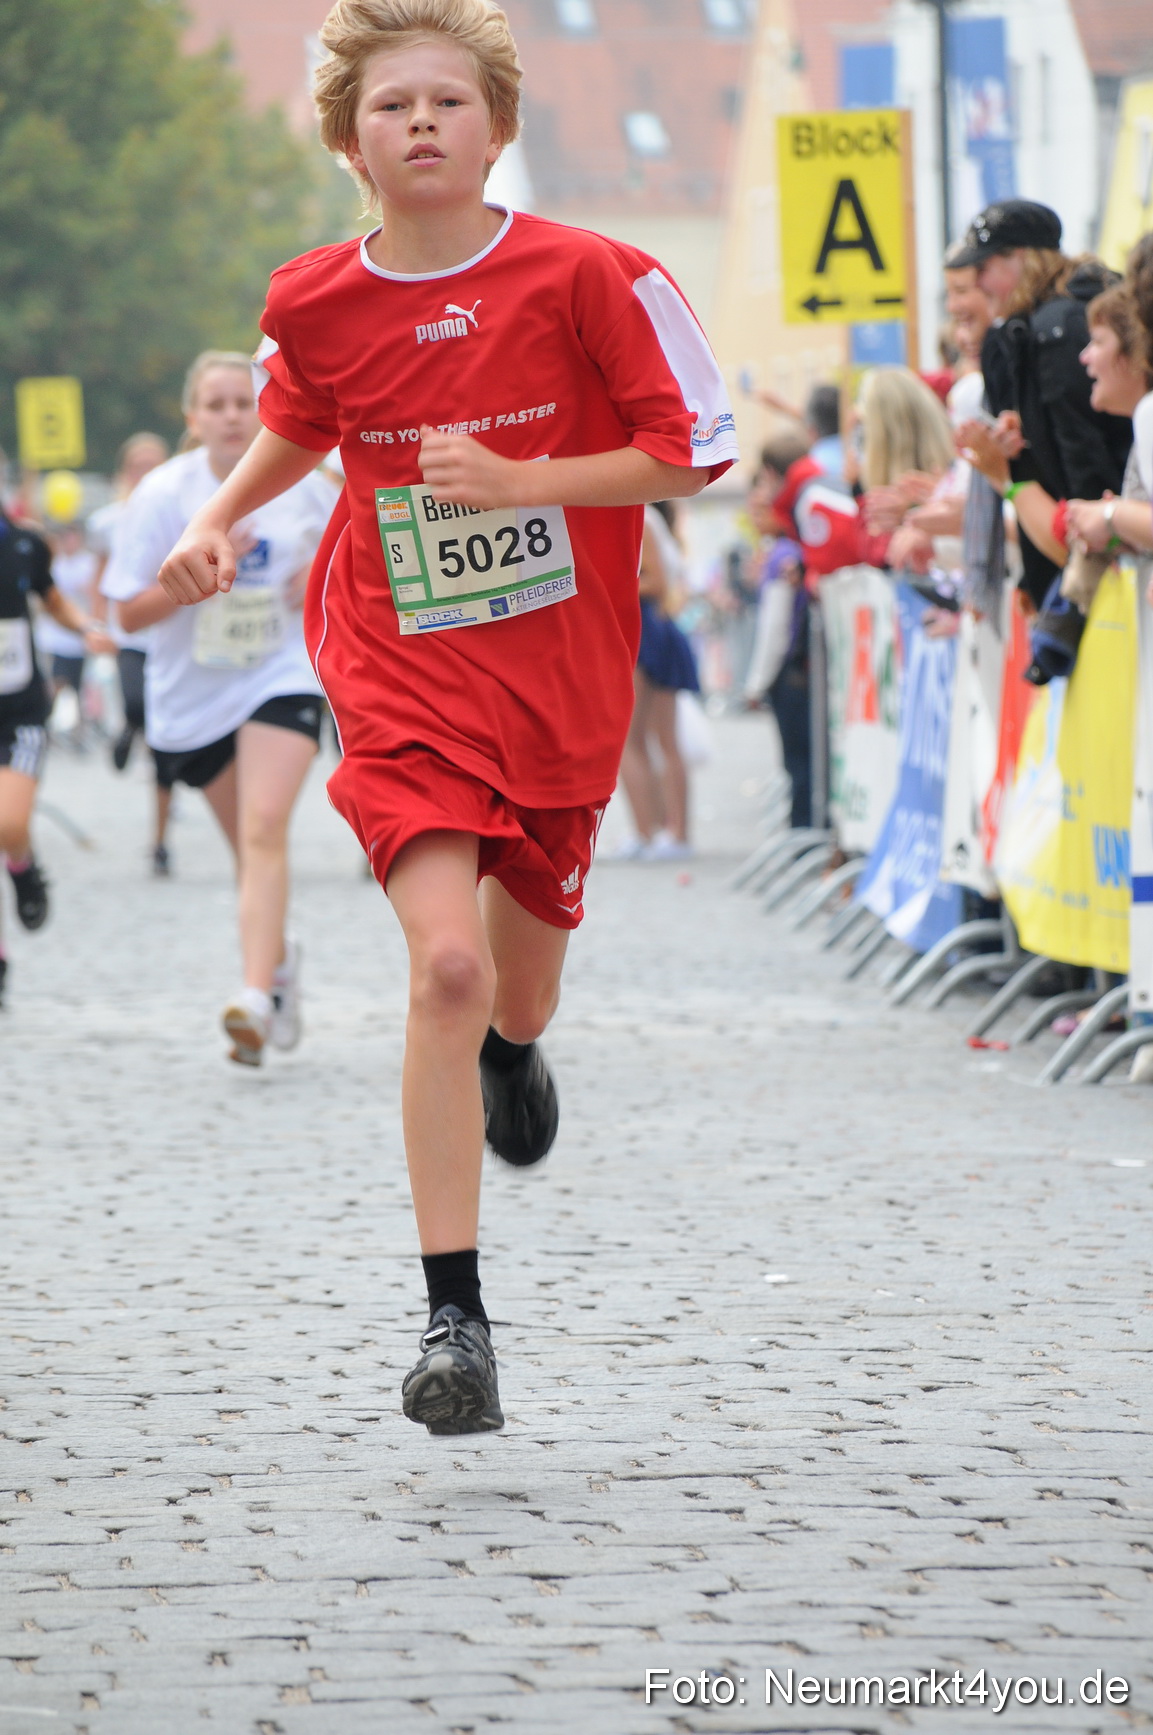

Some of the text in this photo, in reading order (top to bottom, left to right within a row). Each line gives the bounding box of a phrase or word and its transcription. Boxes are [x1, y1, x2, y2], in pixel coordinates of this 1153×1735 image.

[790, 118, 900, 158] Block
[814, 178, 886, 273] A
[415, 317, 468, 344] PUMA
[360, 402, 556, 444] GETS YO THERE FASTER
[391, 543, 403, 564] S
[438, 518, 552, 578] 5028
[509, 576, 573, 606] PFLEIDERER
[416, 608, 463, 625] BOCK
